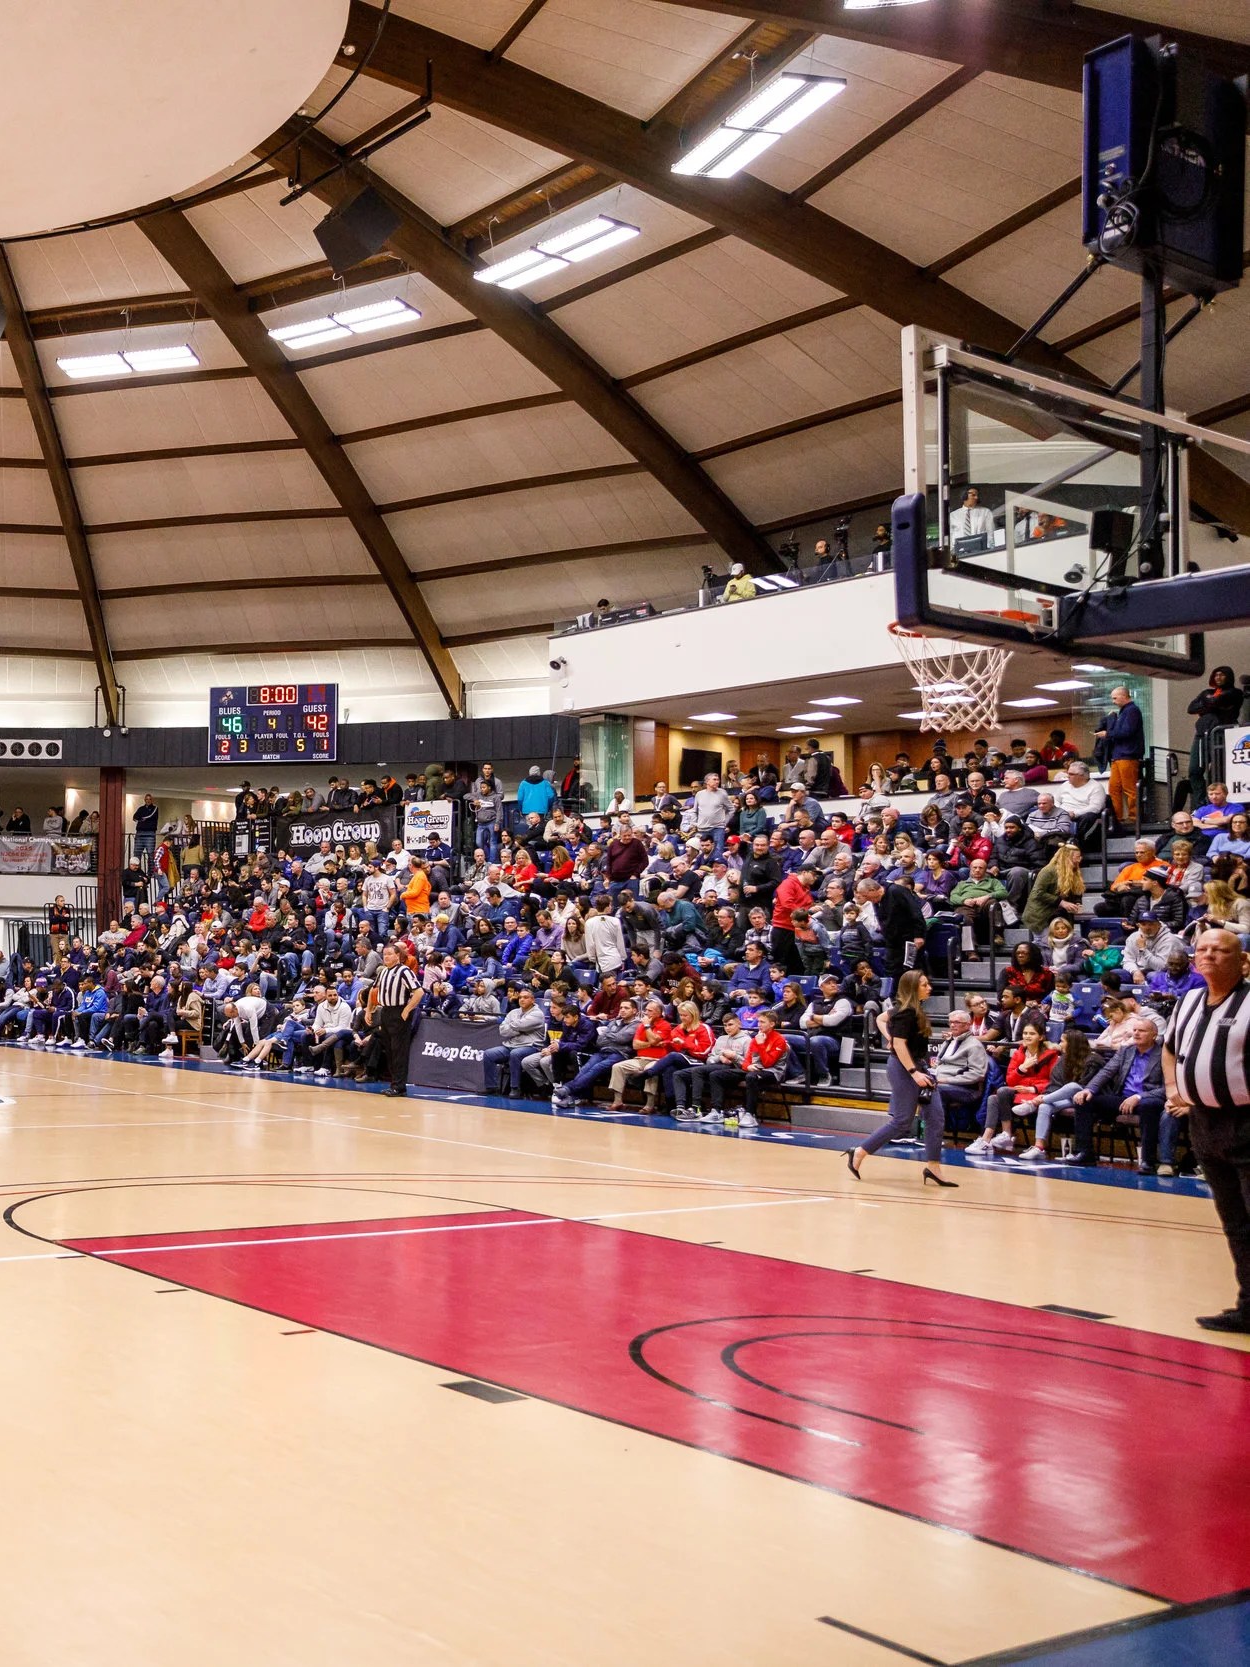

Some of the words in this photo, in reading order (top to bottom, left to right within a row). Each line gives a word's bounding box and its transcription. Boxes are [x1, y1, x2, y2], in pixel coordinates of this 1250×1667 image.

[260, 686, 296, 704] 8:00
[218, 706, 241, 715] BLUES
[302, 704, 327, 713] GUEST
[222, 716, 243, 733] 46
[267, 718, 276, 730] 4
[306, 714, 328, 731] 42
[220, 740, 229, 753] 2
[239, 740, 248, 752] 3
[296, 739, 305, 752] 5
[427, 815, 449, 823] Group
[290, 824, 331, 845] Hoop
[332, 821, 380, 843] Group
[29, 836, 61, 844] Champions
[421, 1041, 459, 1062] Hoop
[459, 1045, 485, 1062] Gro
